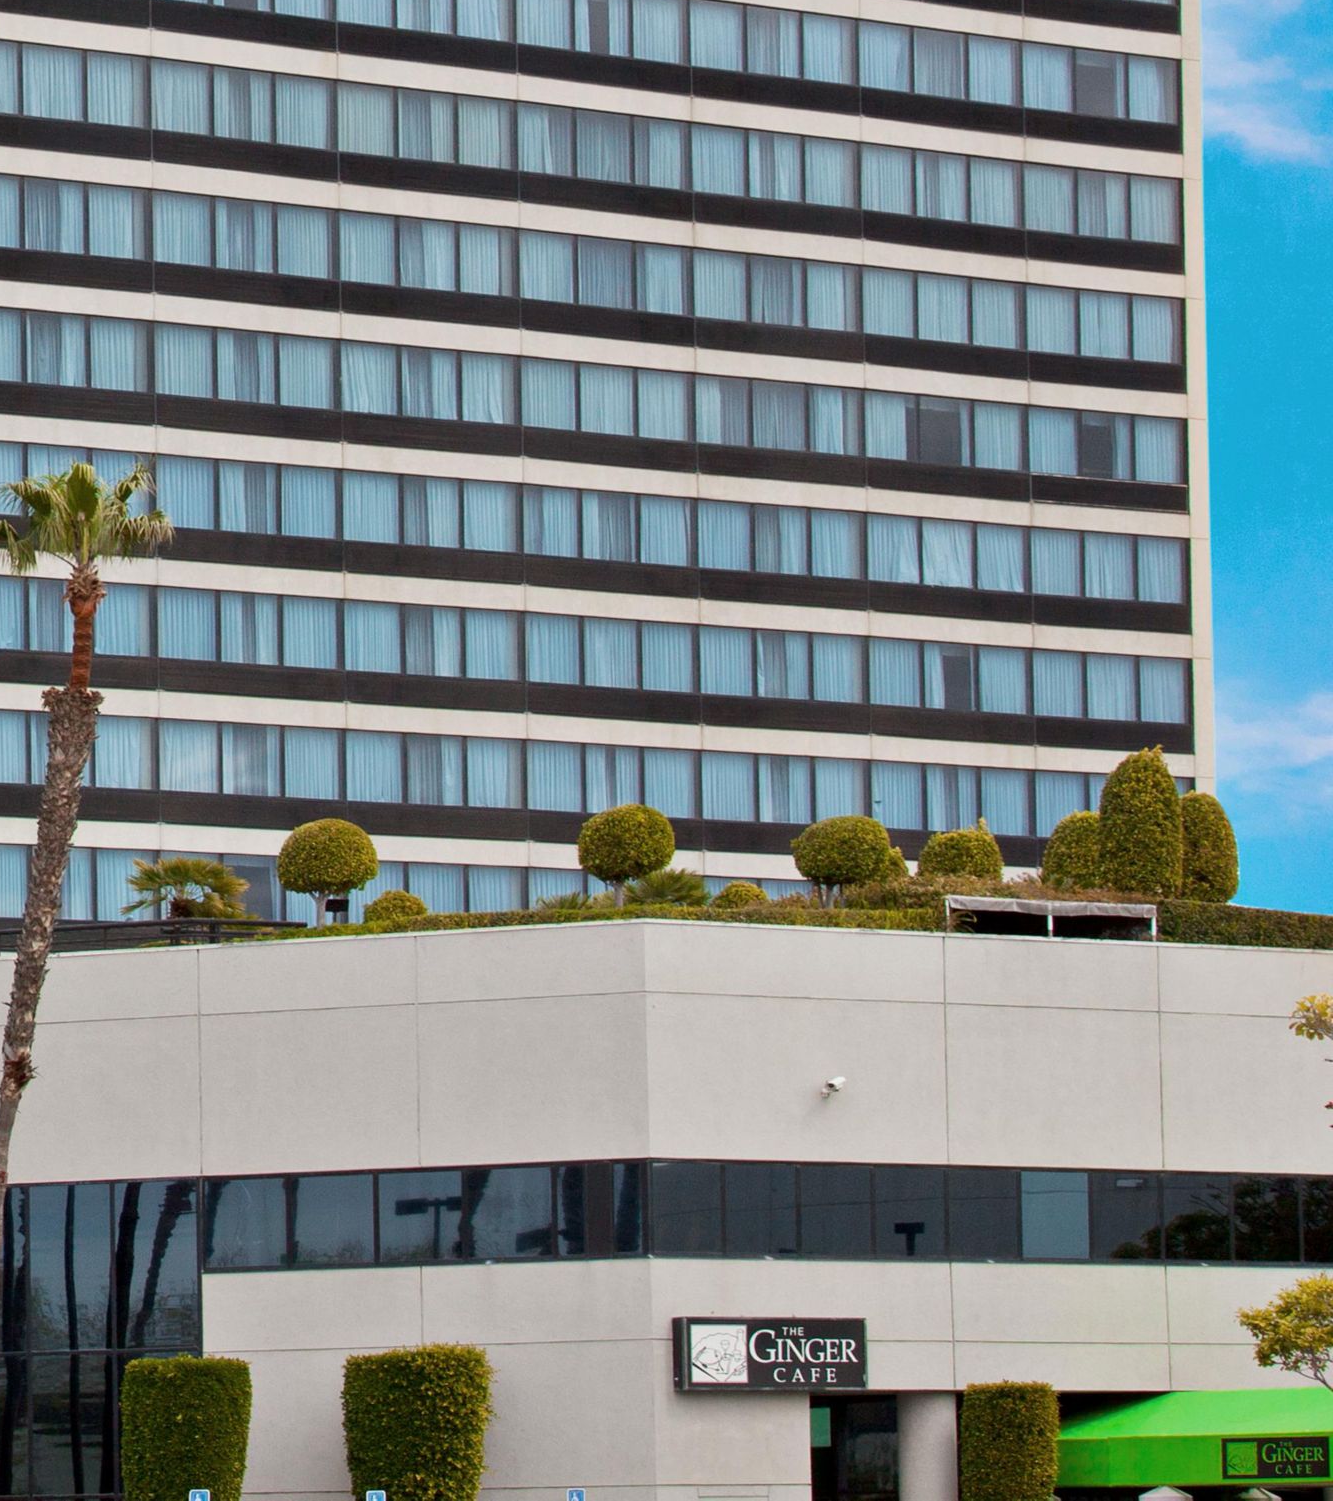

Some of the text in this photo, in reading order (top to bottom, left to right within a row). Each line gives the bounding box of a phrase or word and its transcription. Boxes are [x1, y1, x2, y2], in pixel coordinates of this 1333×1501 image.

[782, 1326, 804, 1336] THE
[748, 1329, 859, 1364] GINGER
[773, 1368, 837, 1383] CAFE
[1261, 1443, 1325, 1464] GINGER
[1275, 1464, 1313, 1475] CAFE
